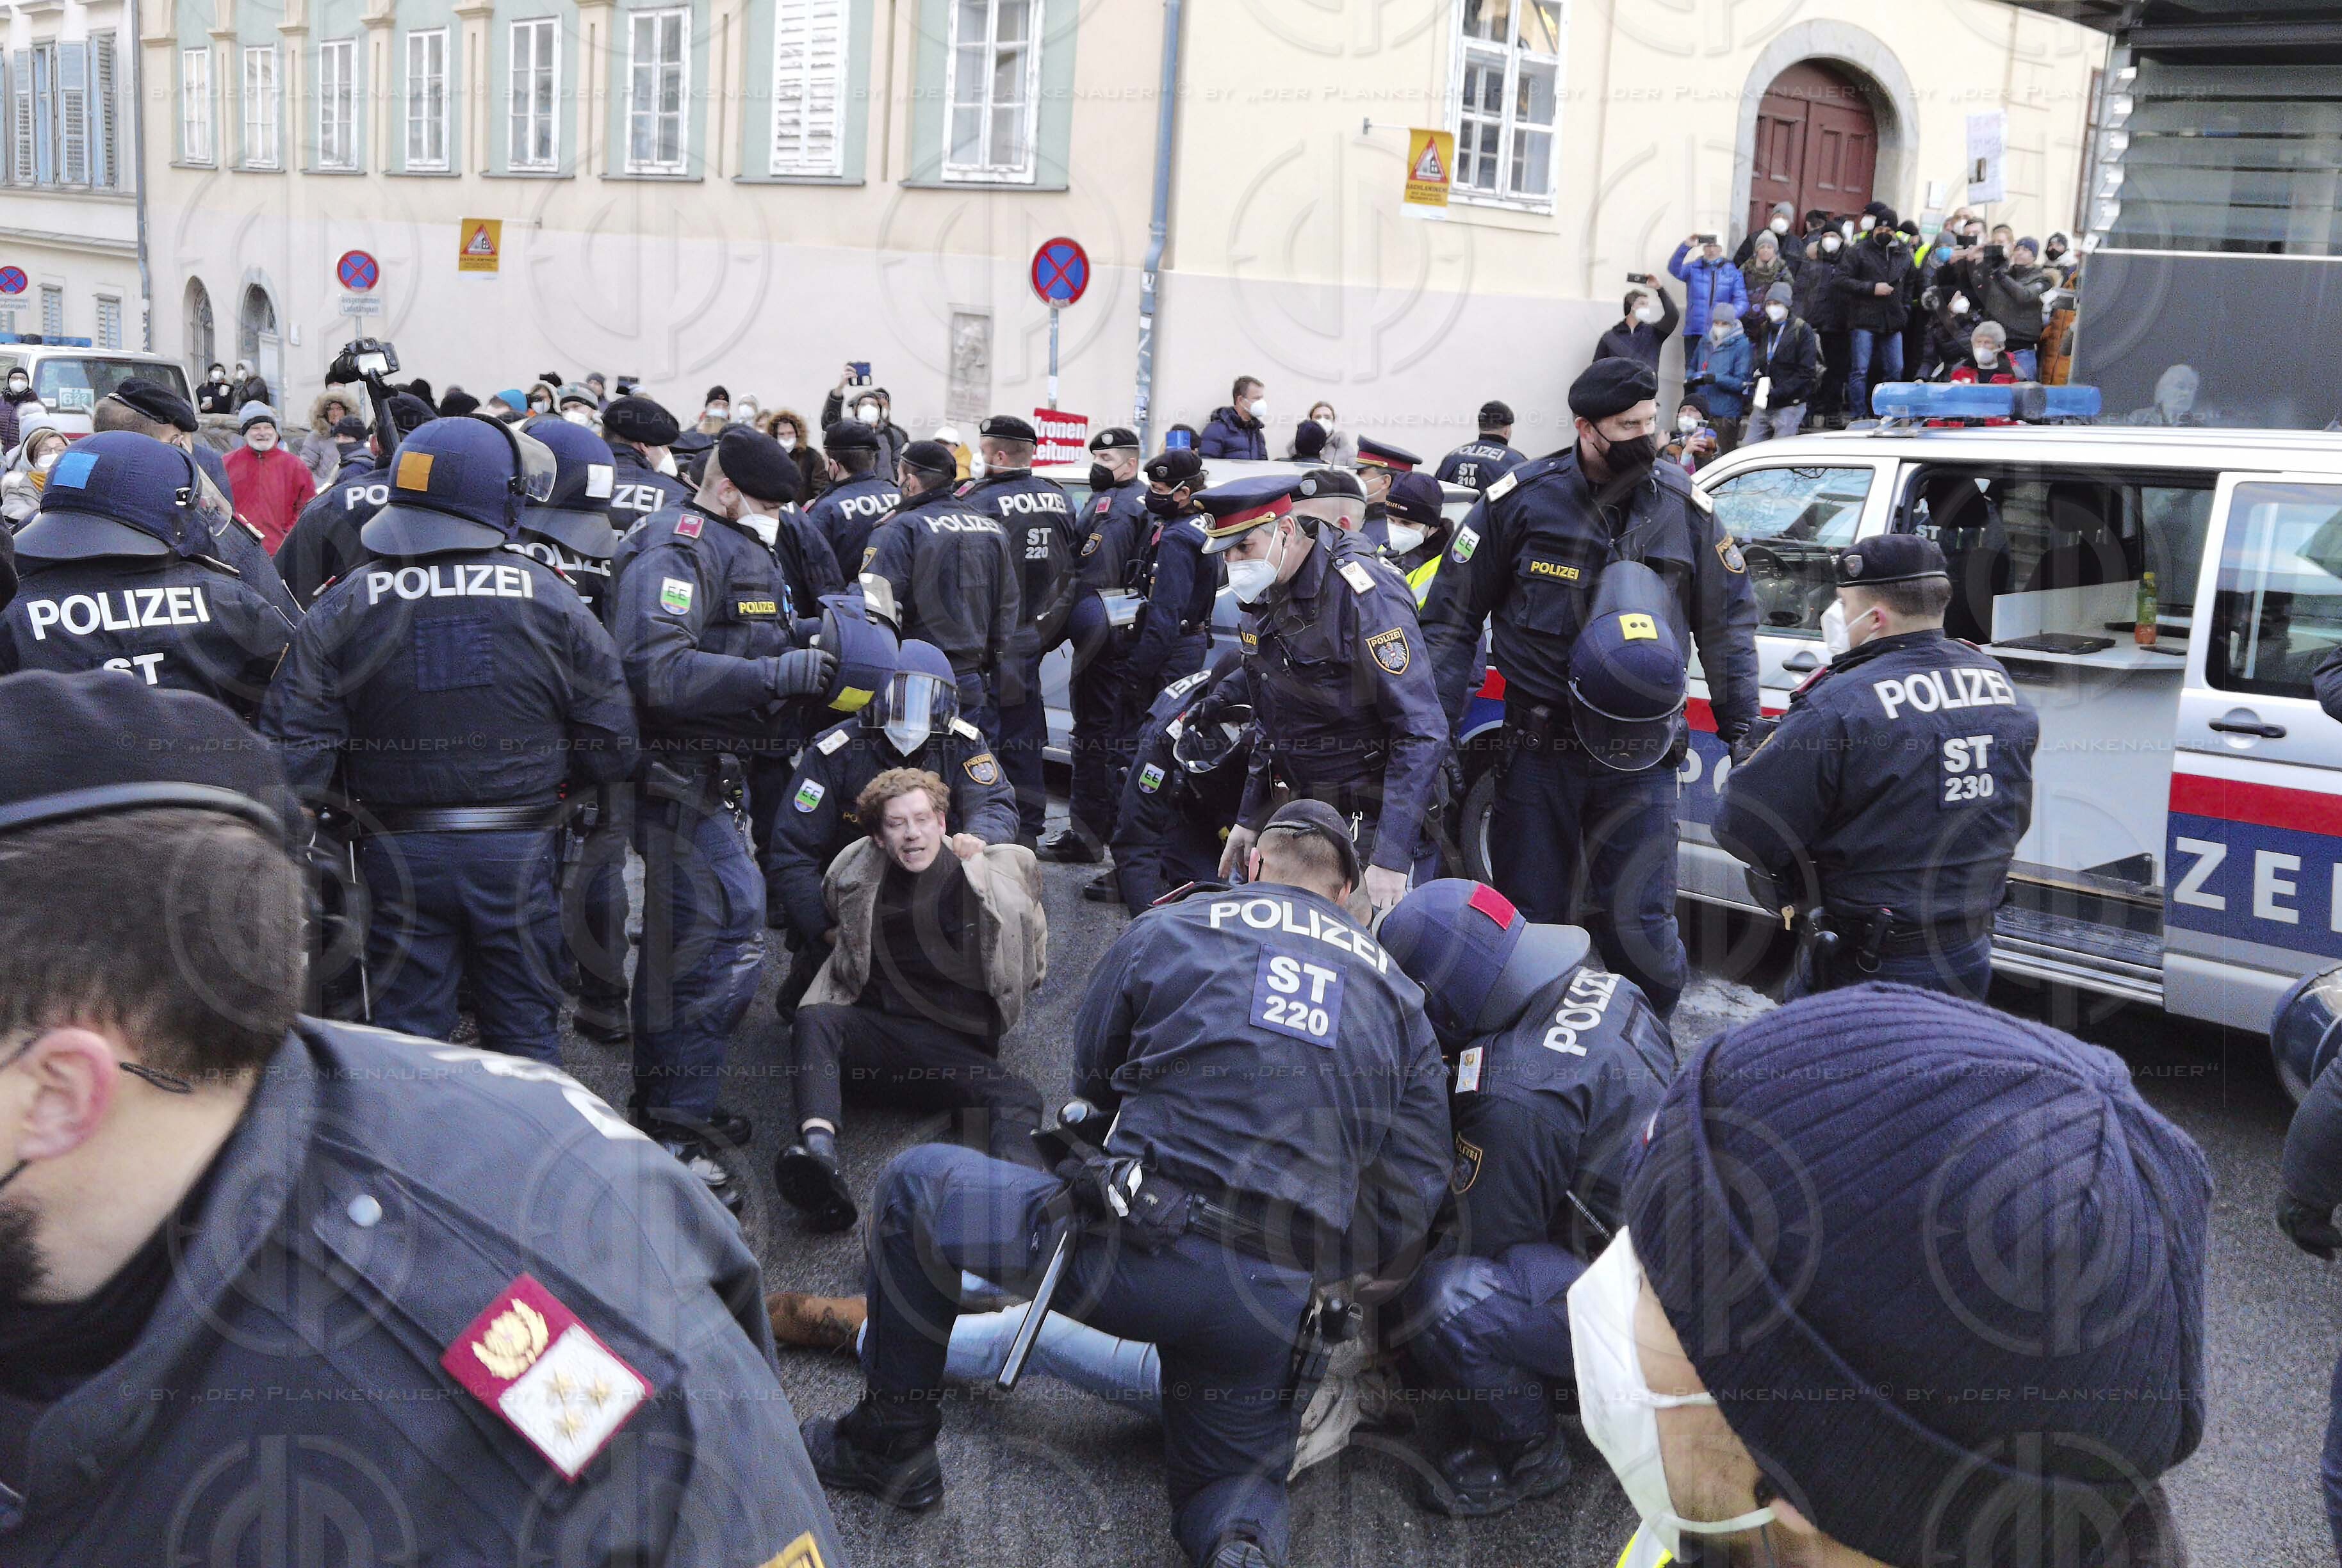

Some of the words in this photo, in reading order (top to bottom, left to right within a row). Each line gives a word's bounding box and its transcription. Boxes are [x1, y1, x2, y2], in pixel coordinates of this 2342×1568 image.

[1032, 440, 1082, 462] eitung
[1459, 462, 1478, 477] ST
[923, 514, 1002, 534] POLIZEI
[1027, 528, 1051, 545] ST
[1025, 546, 1048, 559] 220
[1530, 561, 1580, 580] POLIZEI
[367, 564, 533, 605] POLIZEI
[27, 587, 210, 641] POLIZEI
[738, 601, 777, 614] POLIZEI
[1371, 631, 1402, 648] POLIZEI
[1873, 668, 2017, 719] POLIZEI
[1944, 735, 1994, 773] ST
[1944, 773, 1994, 802] 230
[1210, 899, 1388, 975] POLIZEI
[1266, 956, 1337, 1004] ST
[1263, 995, 1329, 1036] 220
